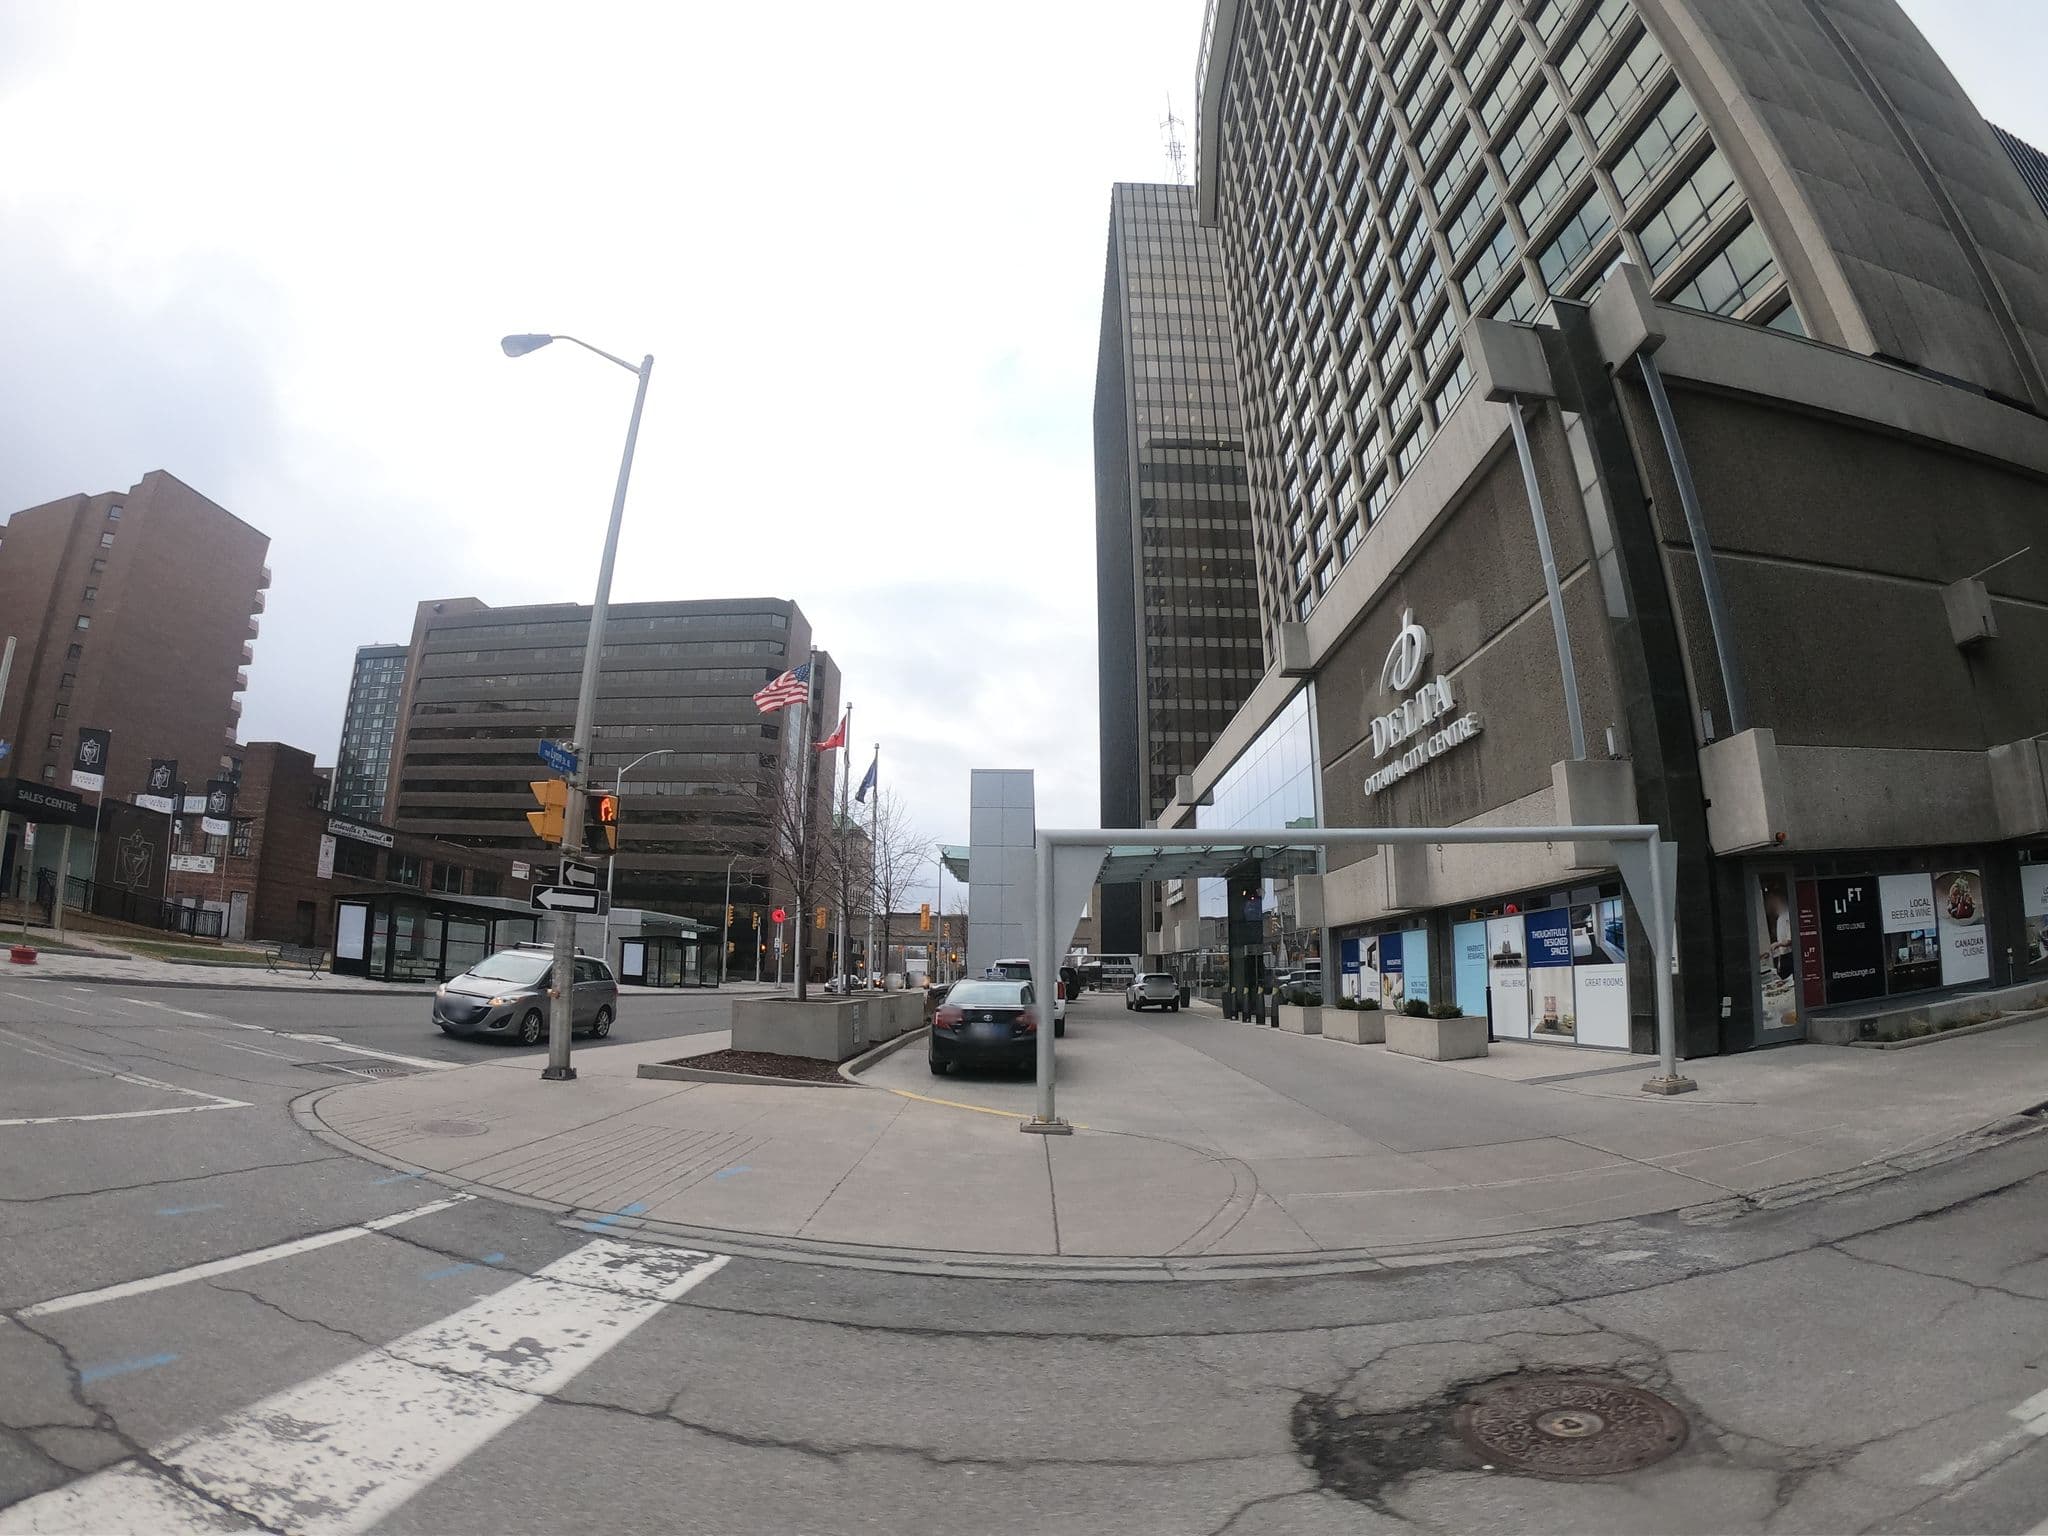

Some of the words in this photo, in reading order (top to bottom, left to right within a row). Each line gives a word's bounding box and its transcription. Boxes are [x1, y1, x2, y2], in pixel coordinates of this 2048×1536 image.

[1370, 675, 1456, 759] DELTA
[1365, 760, 1405, 796] OTTAWA
[1403, 743, 1428, 773] CITY
[1428, 712, 1480, 757] CENTRE
[18, 790, 44, 804] SALES
[45, 796, 78, 812] CENTRE
[1834, 887, 1862, 914] LIFT
[1909, 899, 1931, 908] LOCAL
[1891, 910, 1909, 920] BEER
[1910, 909, 1916, 918] &
[1916, 907, 1932, 918] WINE
[1531, 927, 1568, 939] THOUGHTFULLY
[1543, 937, 1569, 948] DESIGNED
[1955, 937, 1984, 949] CANADIAN
[1550, 947, 1569, 956] SPACES
[1963, 946, 1985, 957] CUISINE
[1584, 978, 1601, 987] GREAT
[1602, 977, 1624, 987] ROOMS
